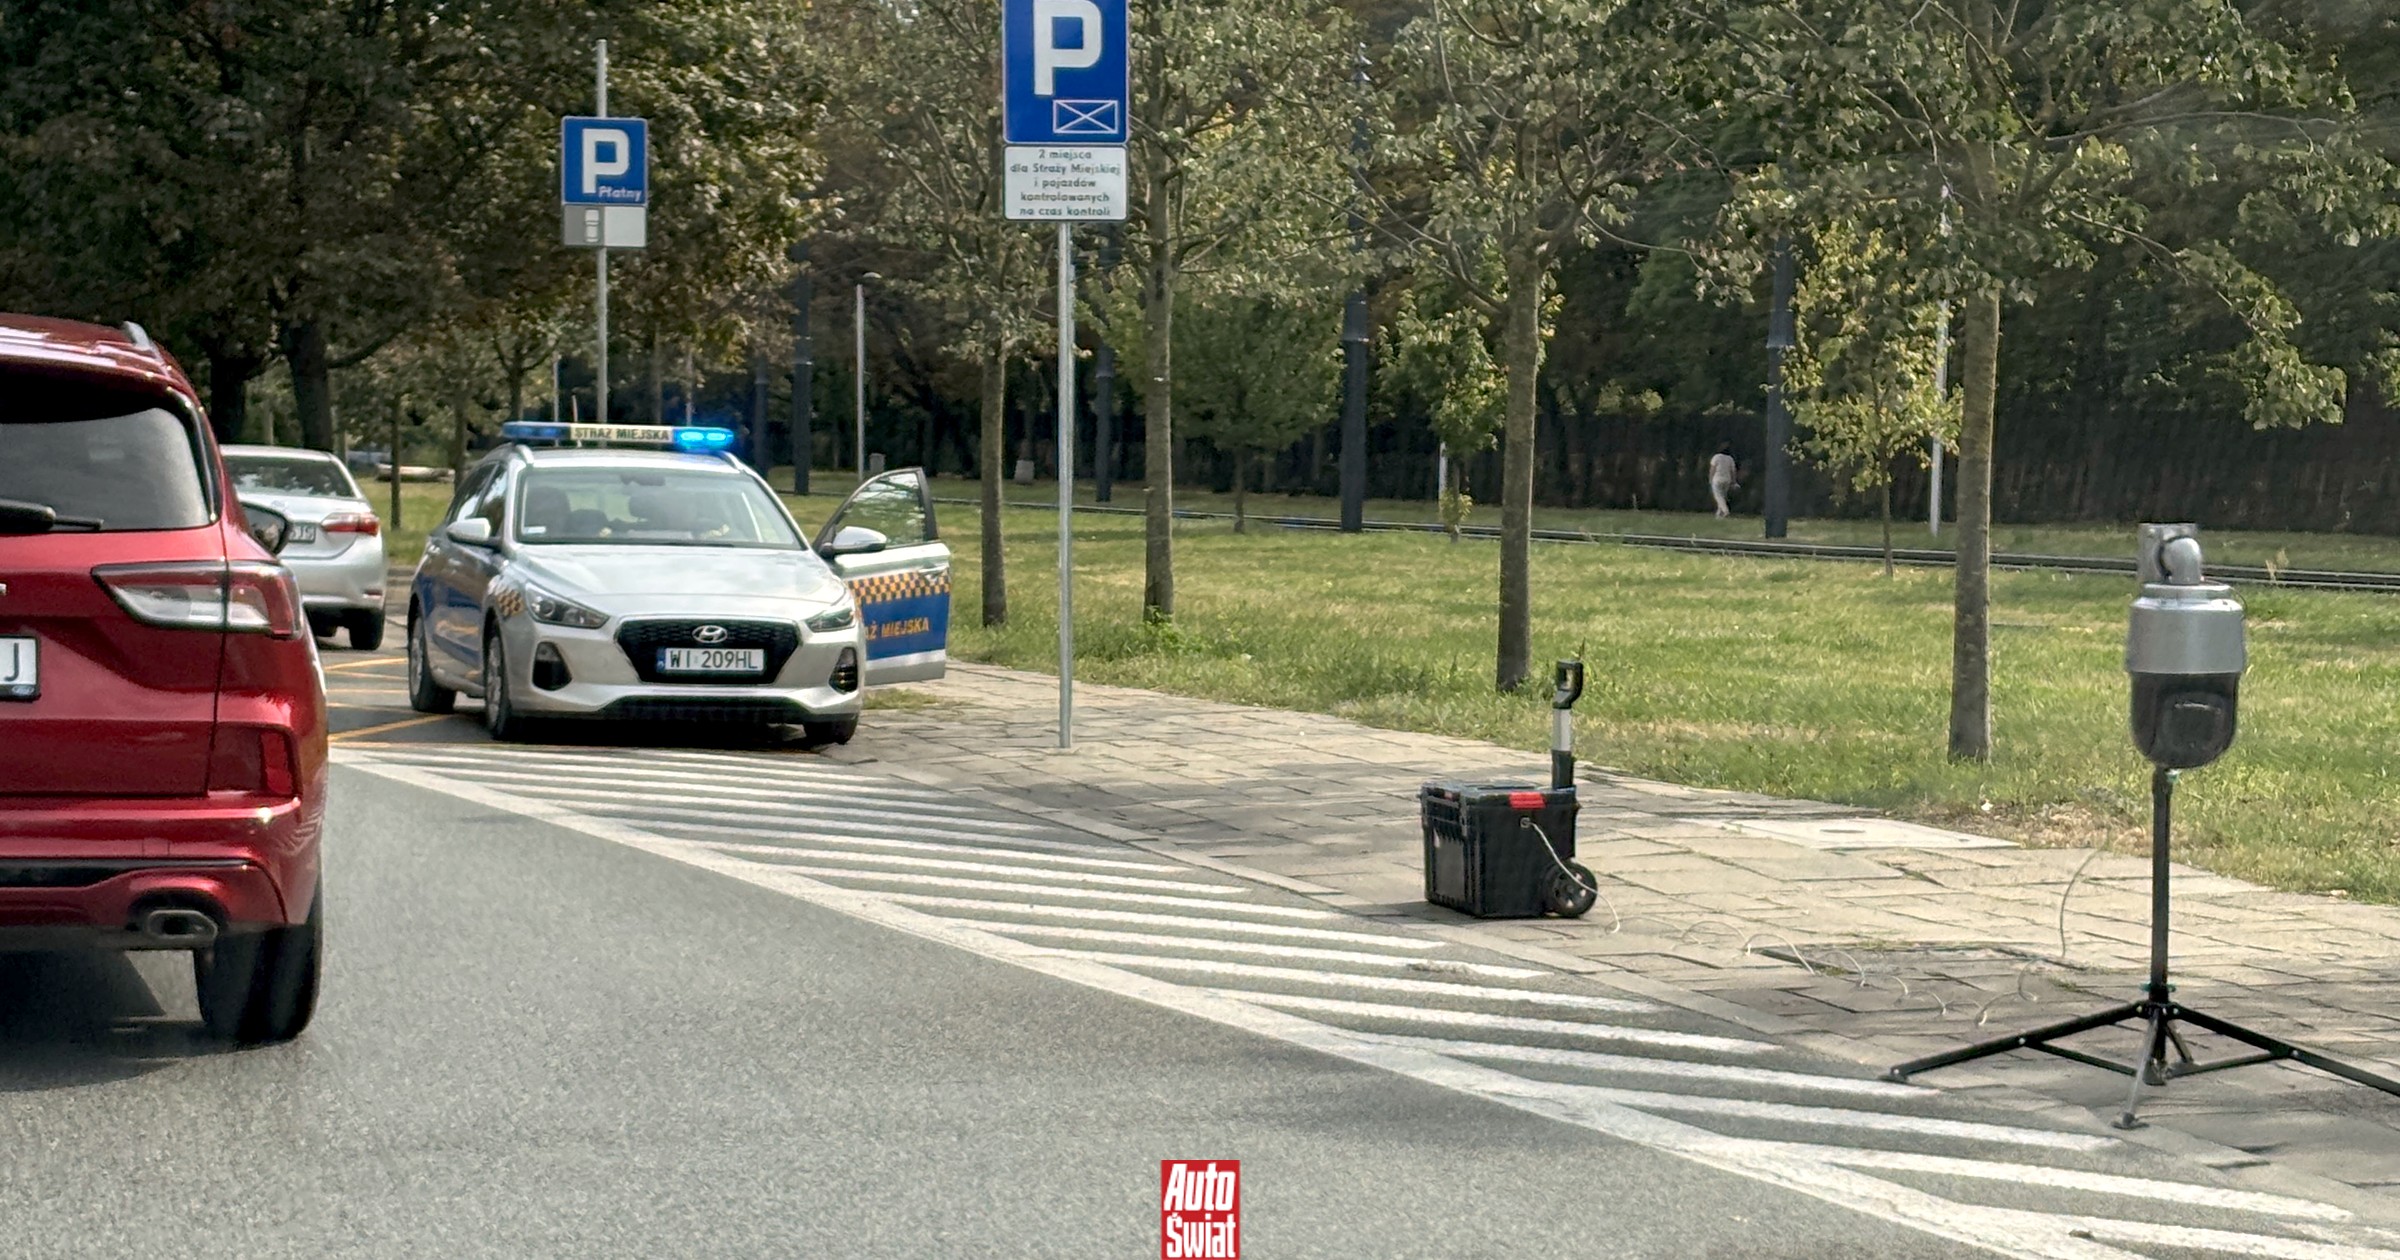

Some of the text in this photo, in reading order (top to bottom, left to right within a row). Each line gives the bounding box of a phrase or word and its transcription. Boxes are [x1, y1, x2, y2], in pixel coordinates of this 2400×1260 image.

[1033, 0, 1101, 95] P
[582, 128, 629, 194] P
[1039, 149, 1091, 161] 2 miejsca
[1010, 163, 1121, 176] dla Straży Miejskiej
[1042, 177, 1096, 188] pojazdów
[1020, 192, 1110, 203] kontrolowanych
[1020, 206, 1110, 216] na czas kontroli
[616, 428, 670, 440] MIEJSKA
[881, 617, 930, 638] MIEJSKA
[670, 650, 691, 668] WI
[701, 650, 758, 669] 209HL
